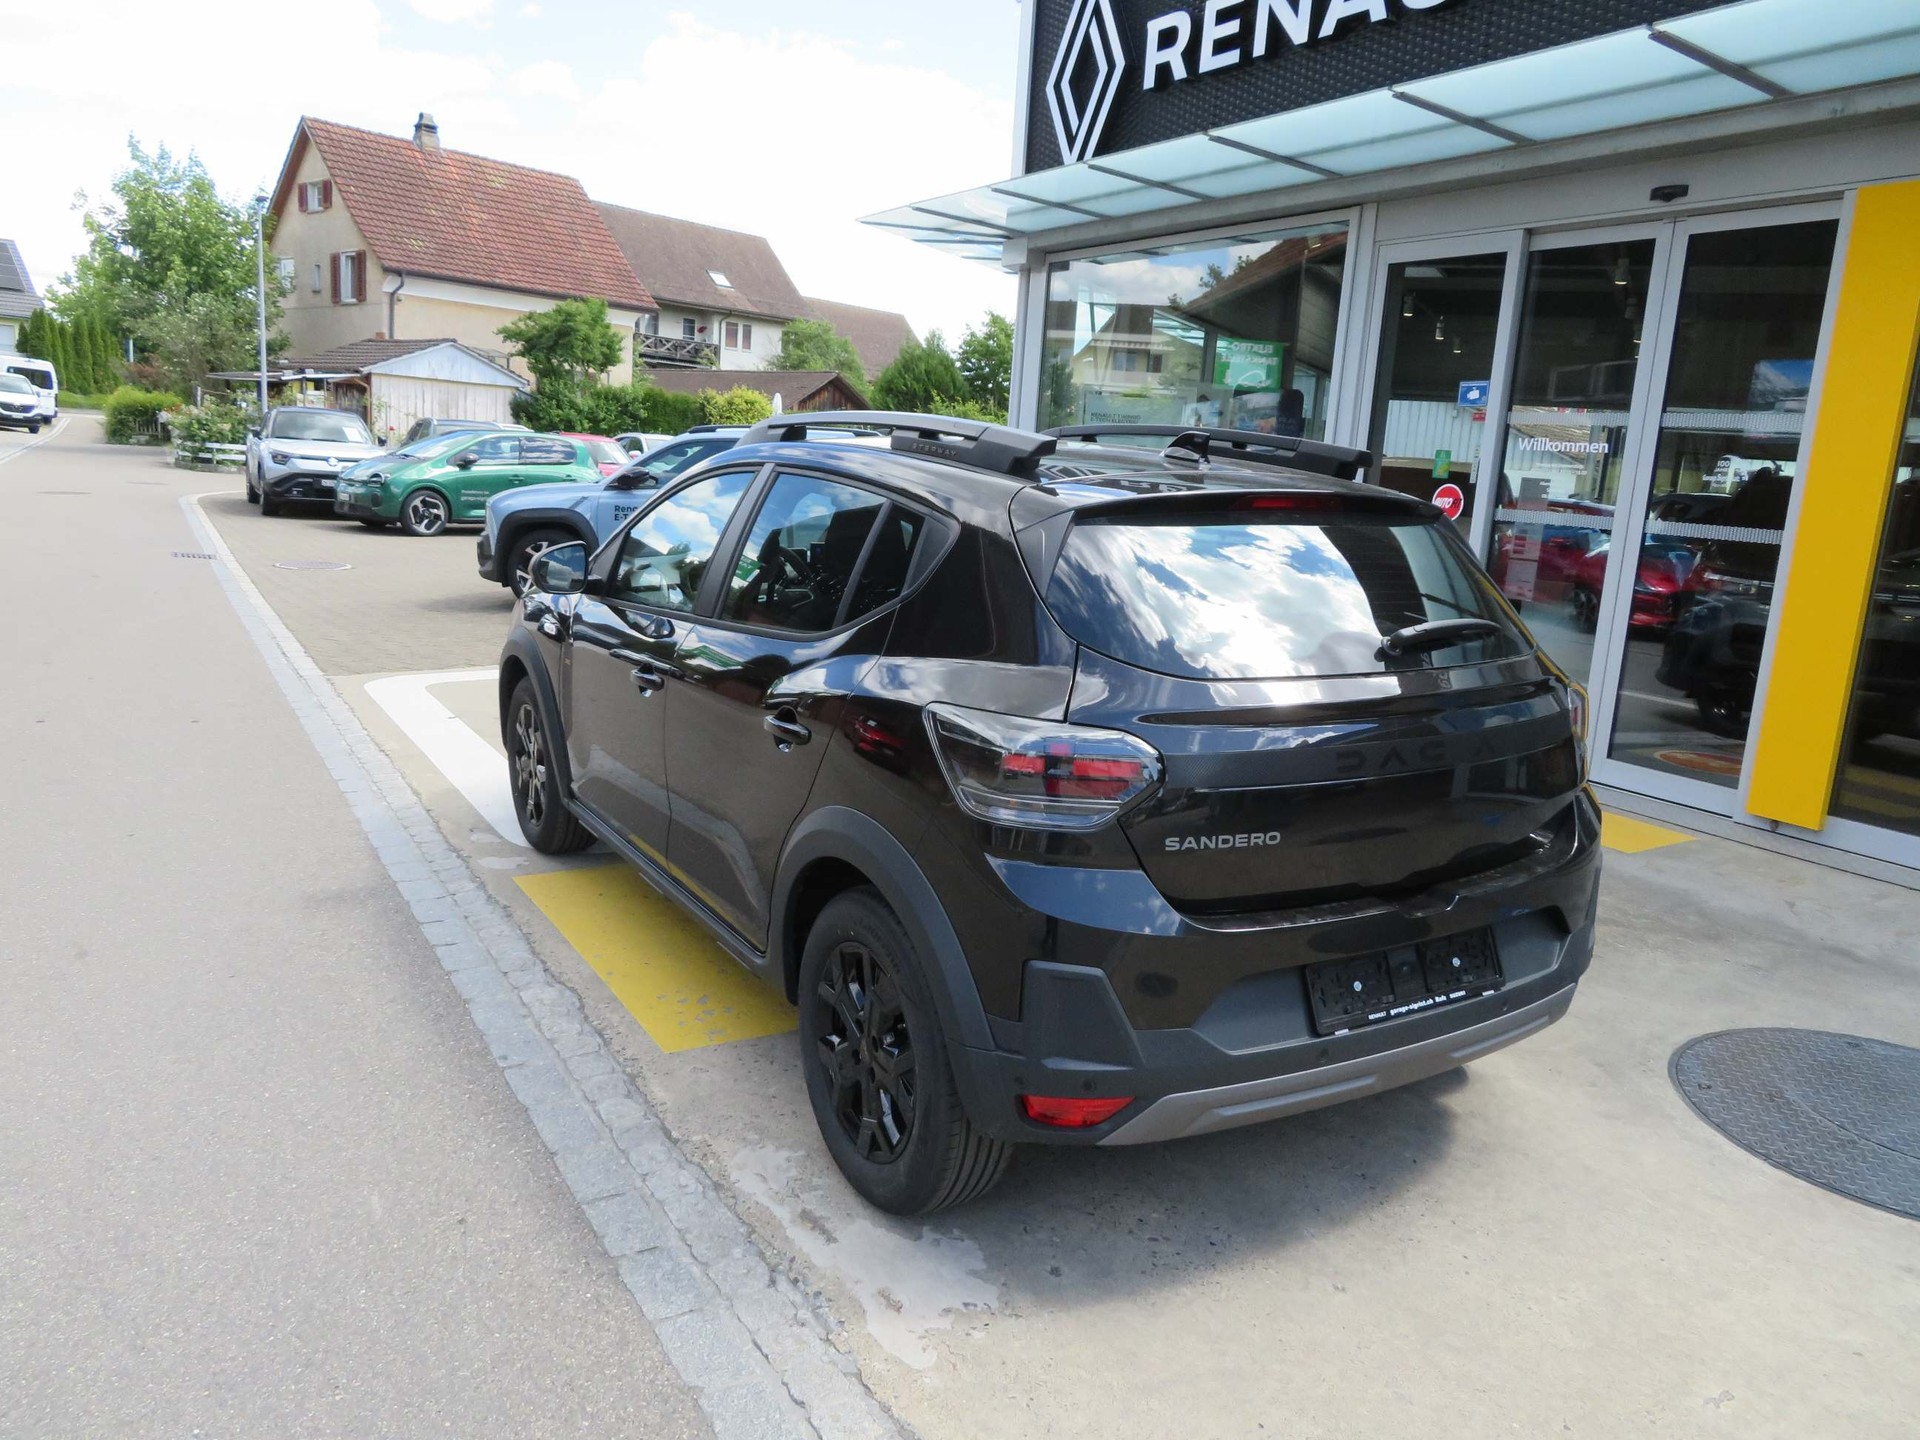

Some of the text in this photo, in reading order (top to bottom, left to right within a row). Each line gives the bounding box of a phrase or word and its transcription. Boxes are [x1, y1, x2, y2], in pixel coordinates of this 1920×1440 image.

[1143, 0, 1447, 90] RENA
[1518, 438, 1609, 453] Willkommen
[1336, 740, 1496, 773] DACA
[1165, 831, 1281, 851] SANDERO
